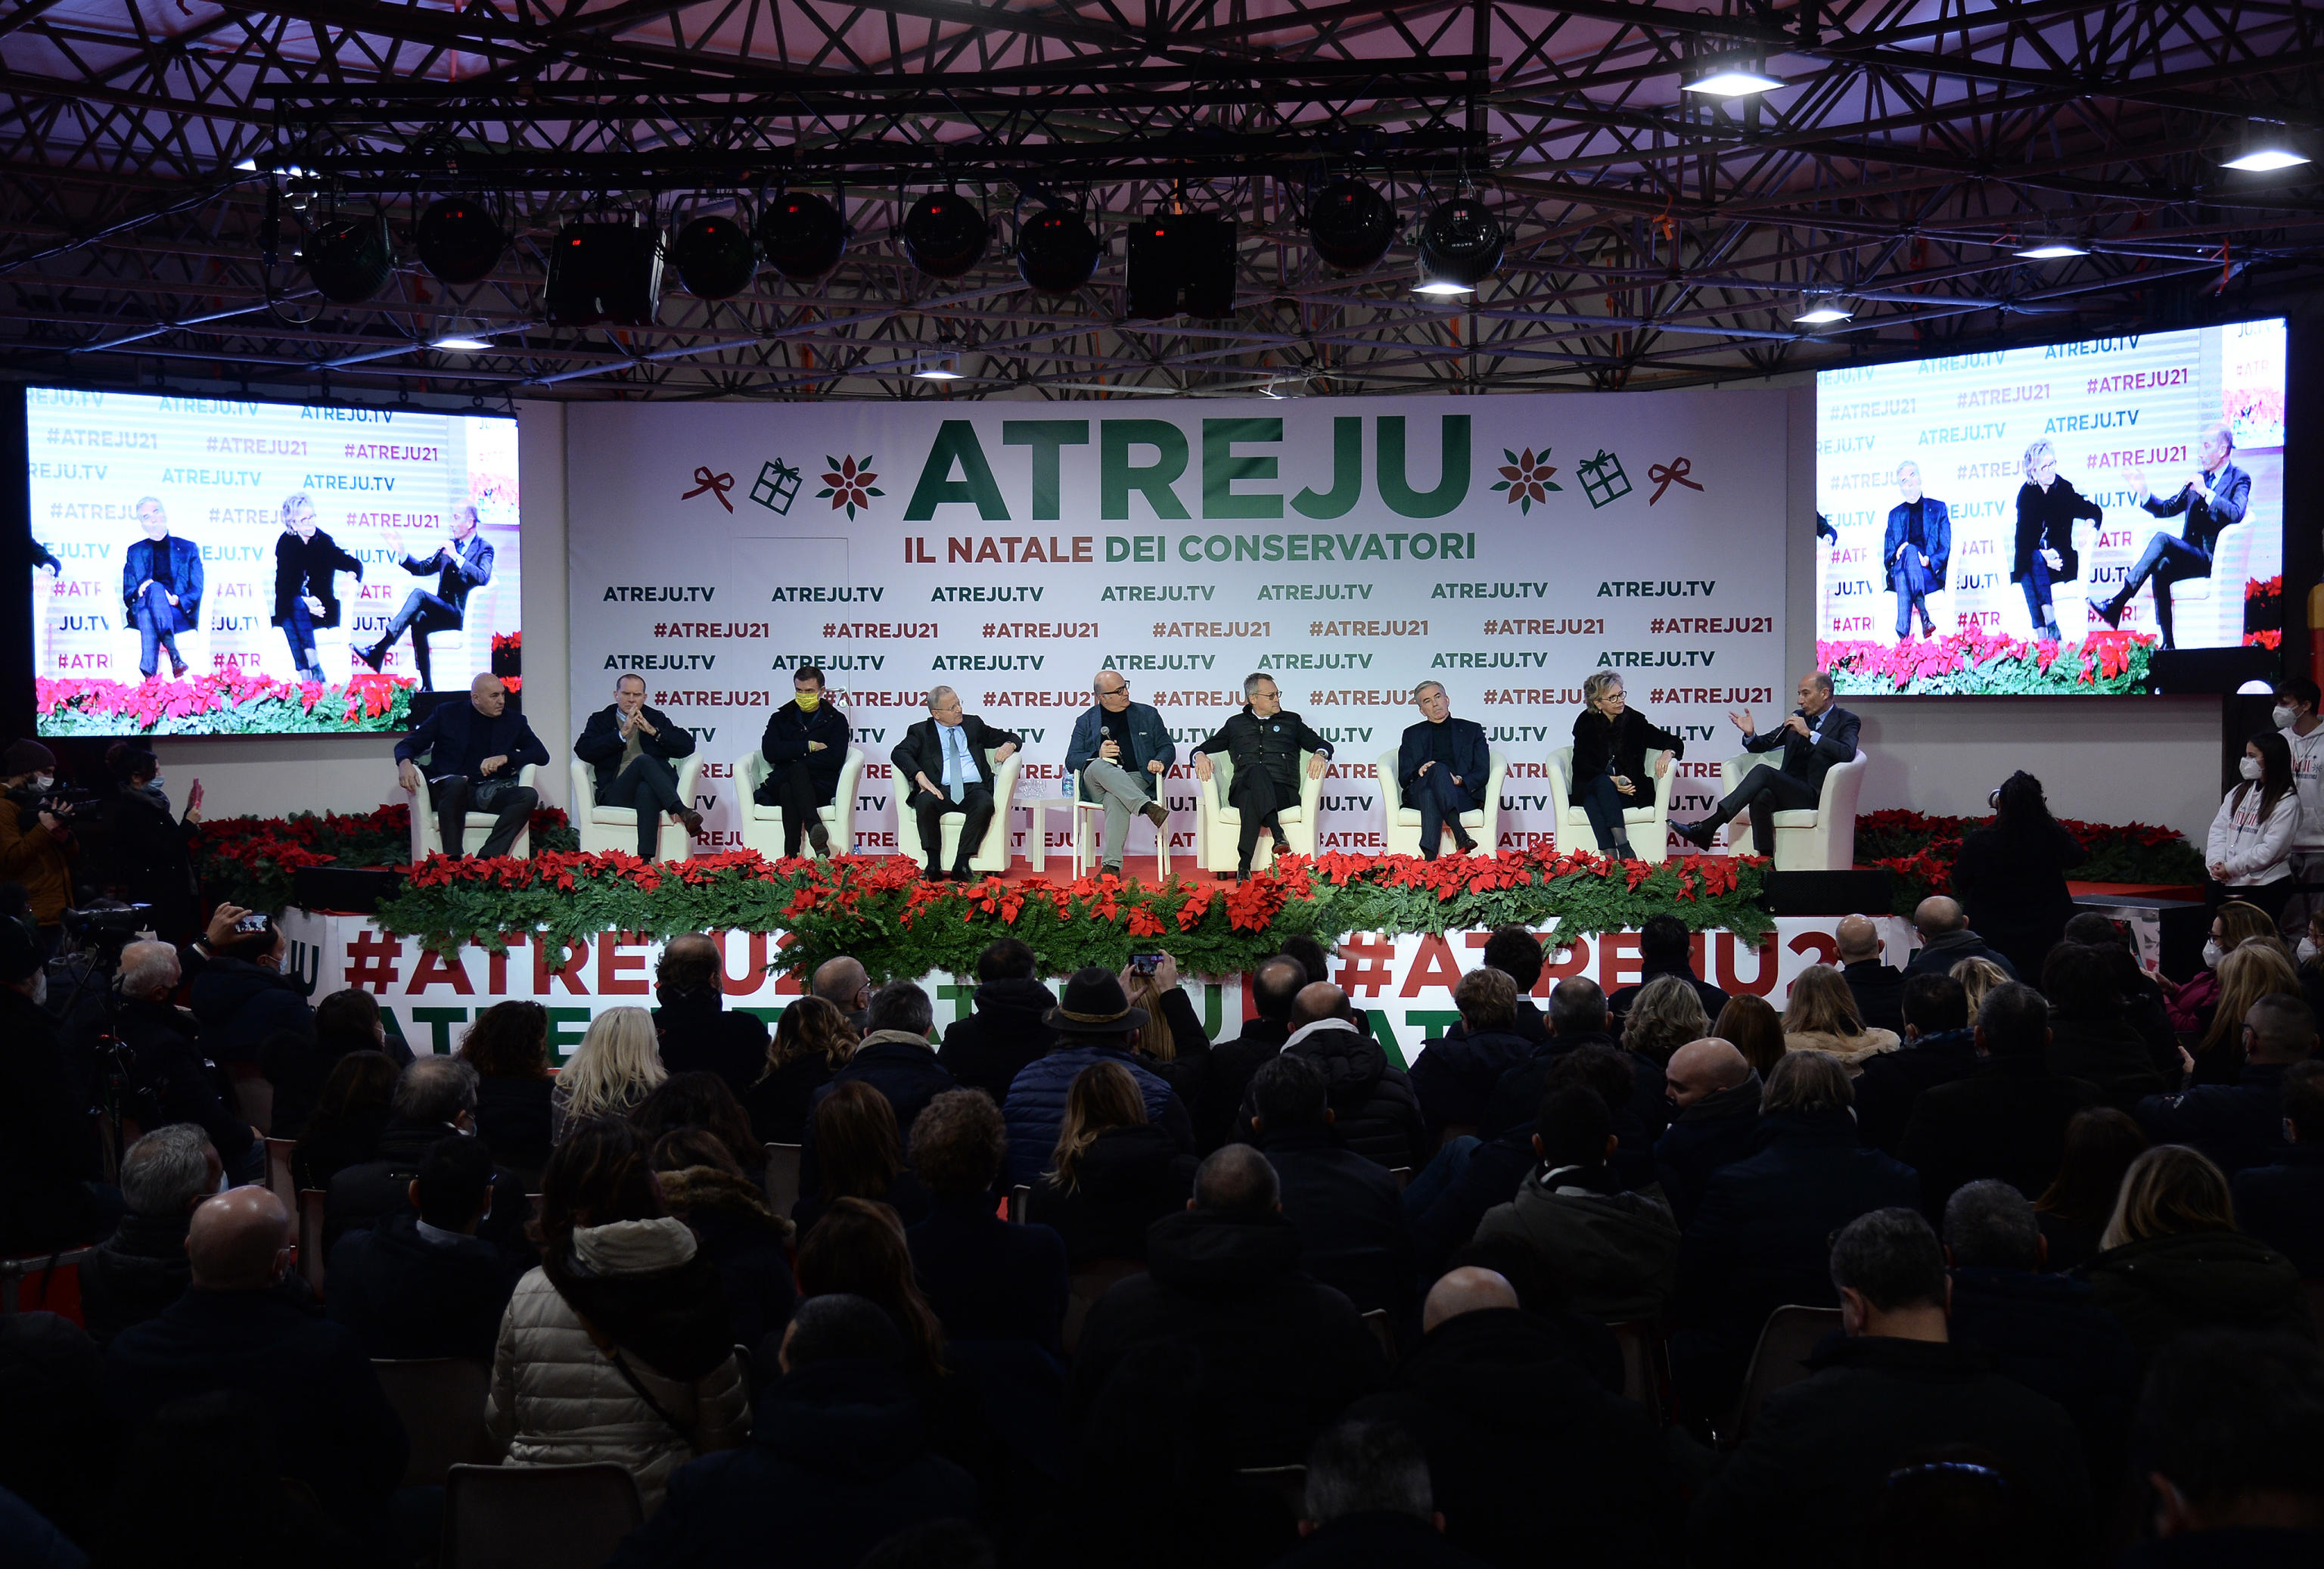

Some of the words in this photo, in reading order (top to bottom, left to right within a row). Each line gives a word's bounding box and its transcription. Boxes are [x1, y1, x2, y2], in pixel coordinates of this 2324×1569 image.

[1830, 398, 1916, 421] #ATREJU21
[1956, 383, 2049, 409] #ATREJU21
[2087, 368, 2188, 394] #ATREJU21
[1918, 422, 2006, 446] ATREJU.TV
[2045, 410, 2139, 433] ATREJU.TV
[47, 427, 157, 449] #ATREJU21
[207, 437, 307, 455] #ATREJU21
[345, 443, 438, 461] #ATREJU21
[903, 415, 1472, 521] ATREJU
[2087, 446, 2187, 469] #ATREJU21
[162, 468, 261, 486] ATREJU.TV
[303, 474, 395, 491] ATREJU.TV
[346, 513, 439, 528] #ATREJU21
[906, 538, 937, 564] IL
[949, 536, 1094, 564] NATALE
[1106, 536, 1167, 563] DEI
[1179, 533, 1476, 562] CONSERVATORI
[604, 587, 716, 602] ATREJU.TV
[772, 587, 884, 602] ATREJU.TV
[931, 587, 1045, 602] ATREJU.TV
[1101, 586, 1216, 601] ATREJU.TV
[1258, 584, 1374, 601] ATREJU.TV
[1431, 583, 1549, 599] ATREJU.TV
[1597, 581, 1717, 598] ATREJU.TV
[654, 623, 769, 638] #ATREJU21
[823, 623, 939, 638] #ATREJU21
[983, 623, 1099, 638] #ATREJU21
[1153, 622, 1271, 638] #ATREJU21
[1310, 620, 1429, 637] #ATREJU21
[1484, 619, 1605, 635] #ATREJU21
[1651, 617, 1773, 634] #ATREJU21
[604, 655, 716, 670] ATREJU.TV
[772, 656, 885, 671] ATREJU.TV
[932, 656, 1045, 671] ATREJU.TV
[1101, 654, 1216, 670] ATREJU.TV
[1258, 654, 1374, 670] ATREJU.TV
[1431, 653, 1549, 669] ATREJU.TV
[1597, 651, 1716, 667] ATREJU.TV
[654, 691, 770, 707] #ATREJU21
[1154, 691, 1248, 706] #ATREJU
[1484, 688, 1585, 704] #ATREJU
[1651, 688, 1773, 704] #ATREJU21
